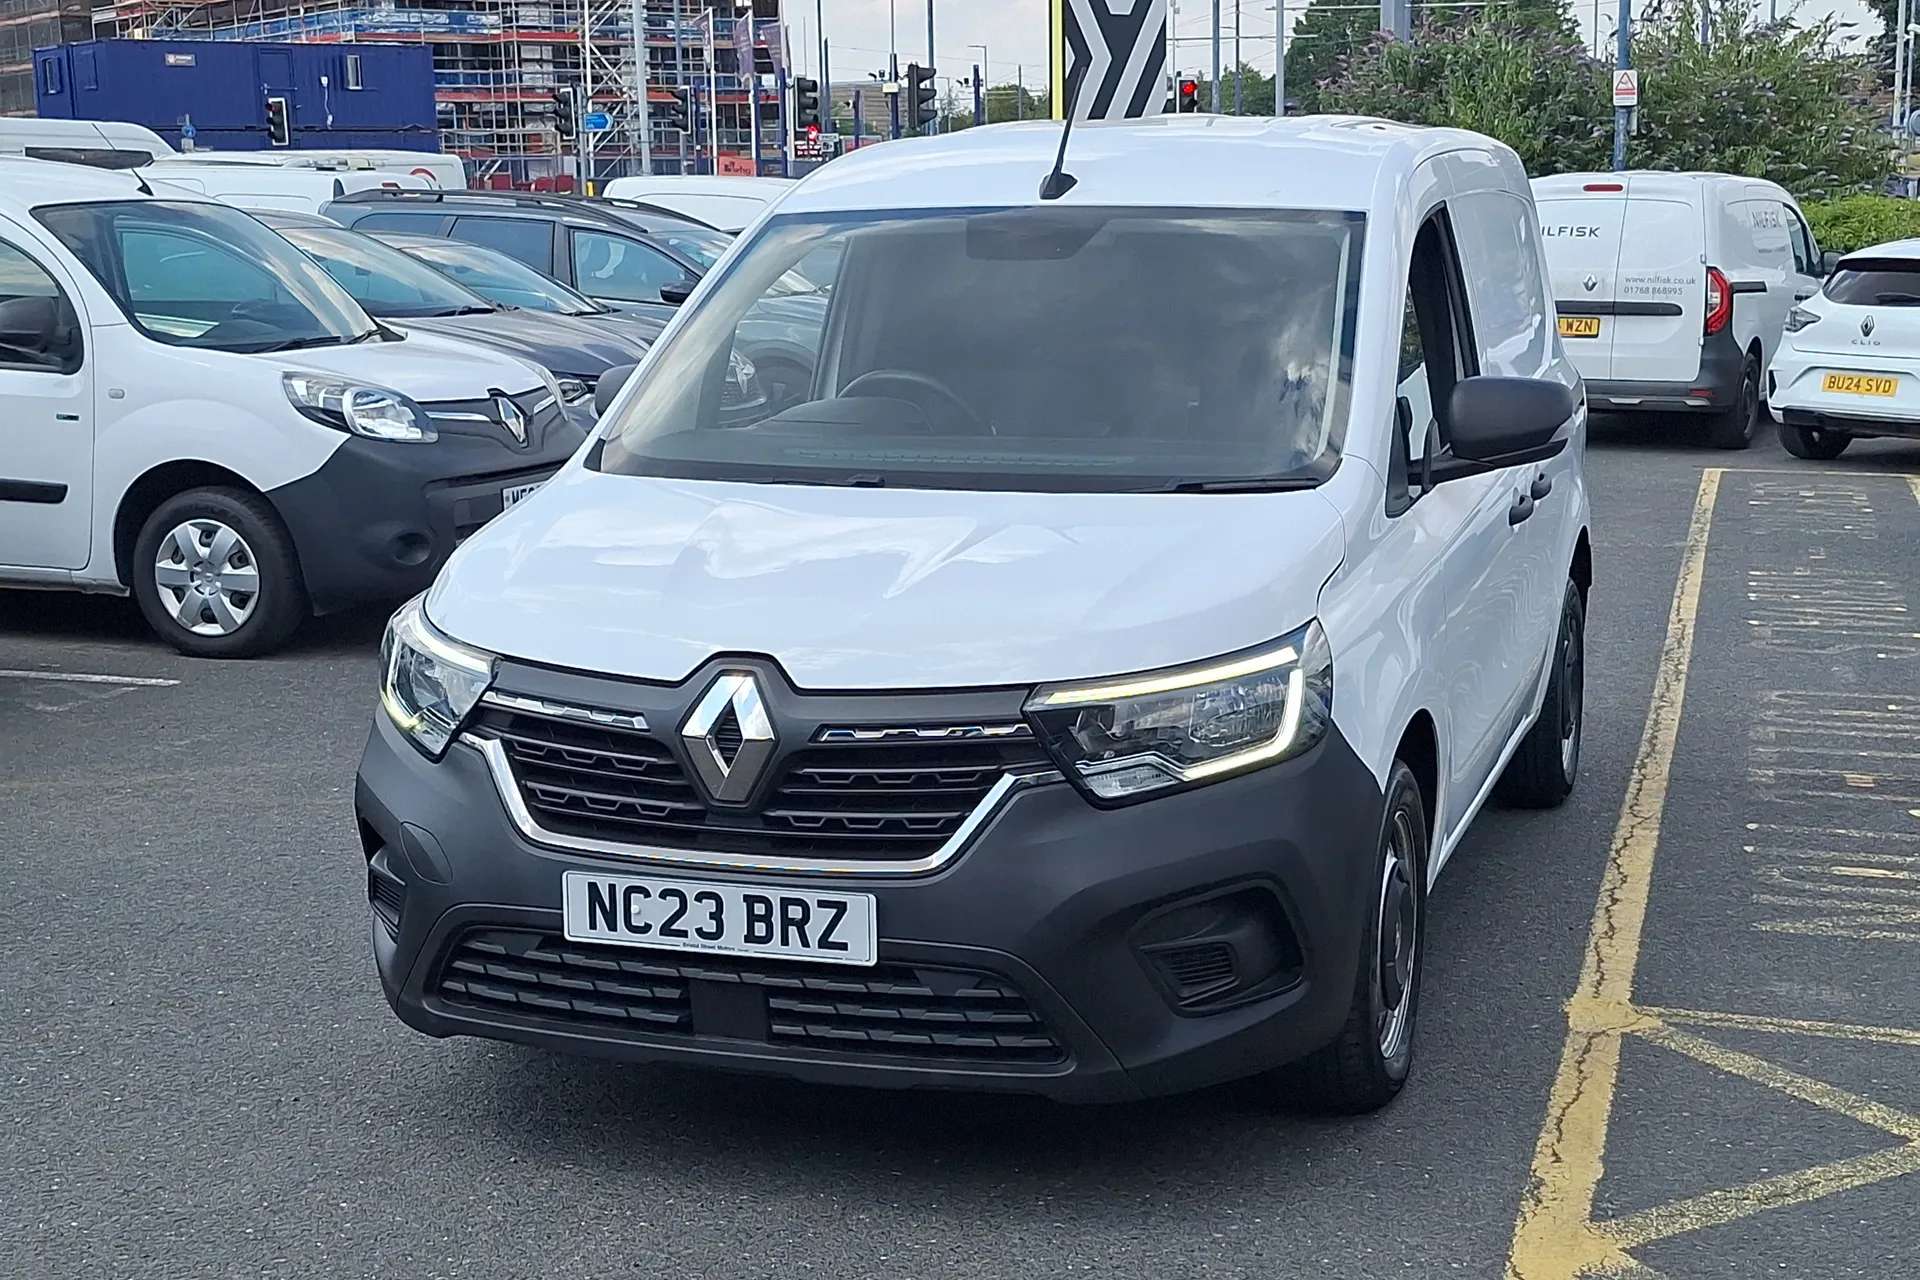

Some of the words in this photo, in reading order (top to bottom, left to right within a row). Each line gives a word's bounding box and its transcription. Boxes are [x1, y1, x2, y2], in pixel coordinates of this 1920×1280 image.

[1541, 226, 1600, 238] ILFISK
[1566, 319, 1593, 333] WZN
[1827, 375, 1861, 391] BU24
[1865, 378, 1892, 394] SVD
[587, 881, 725, 942] NC23
[742, 893, 849, 952] BRZ
